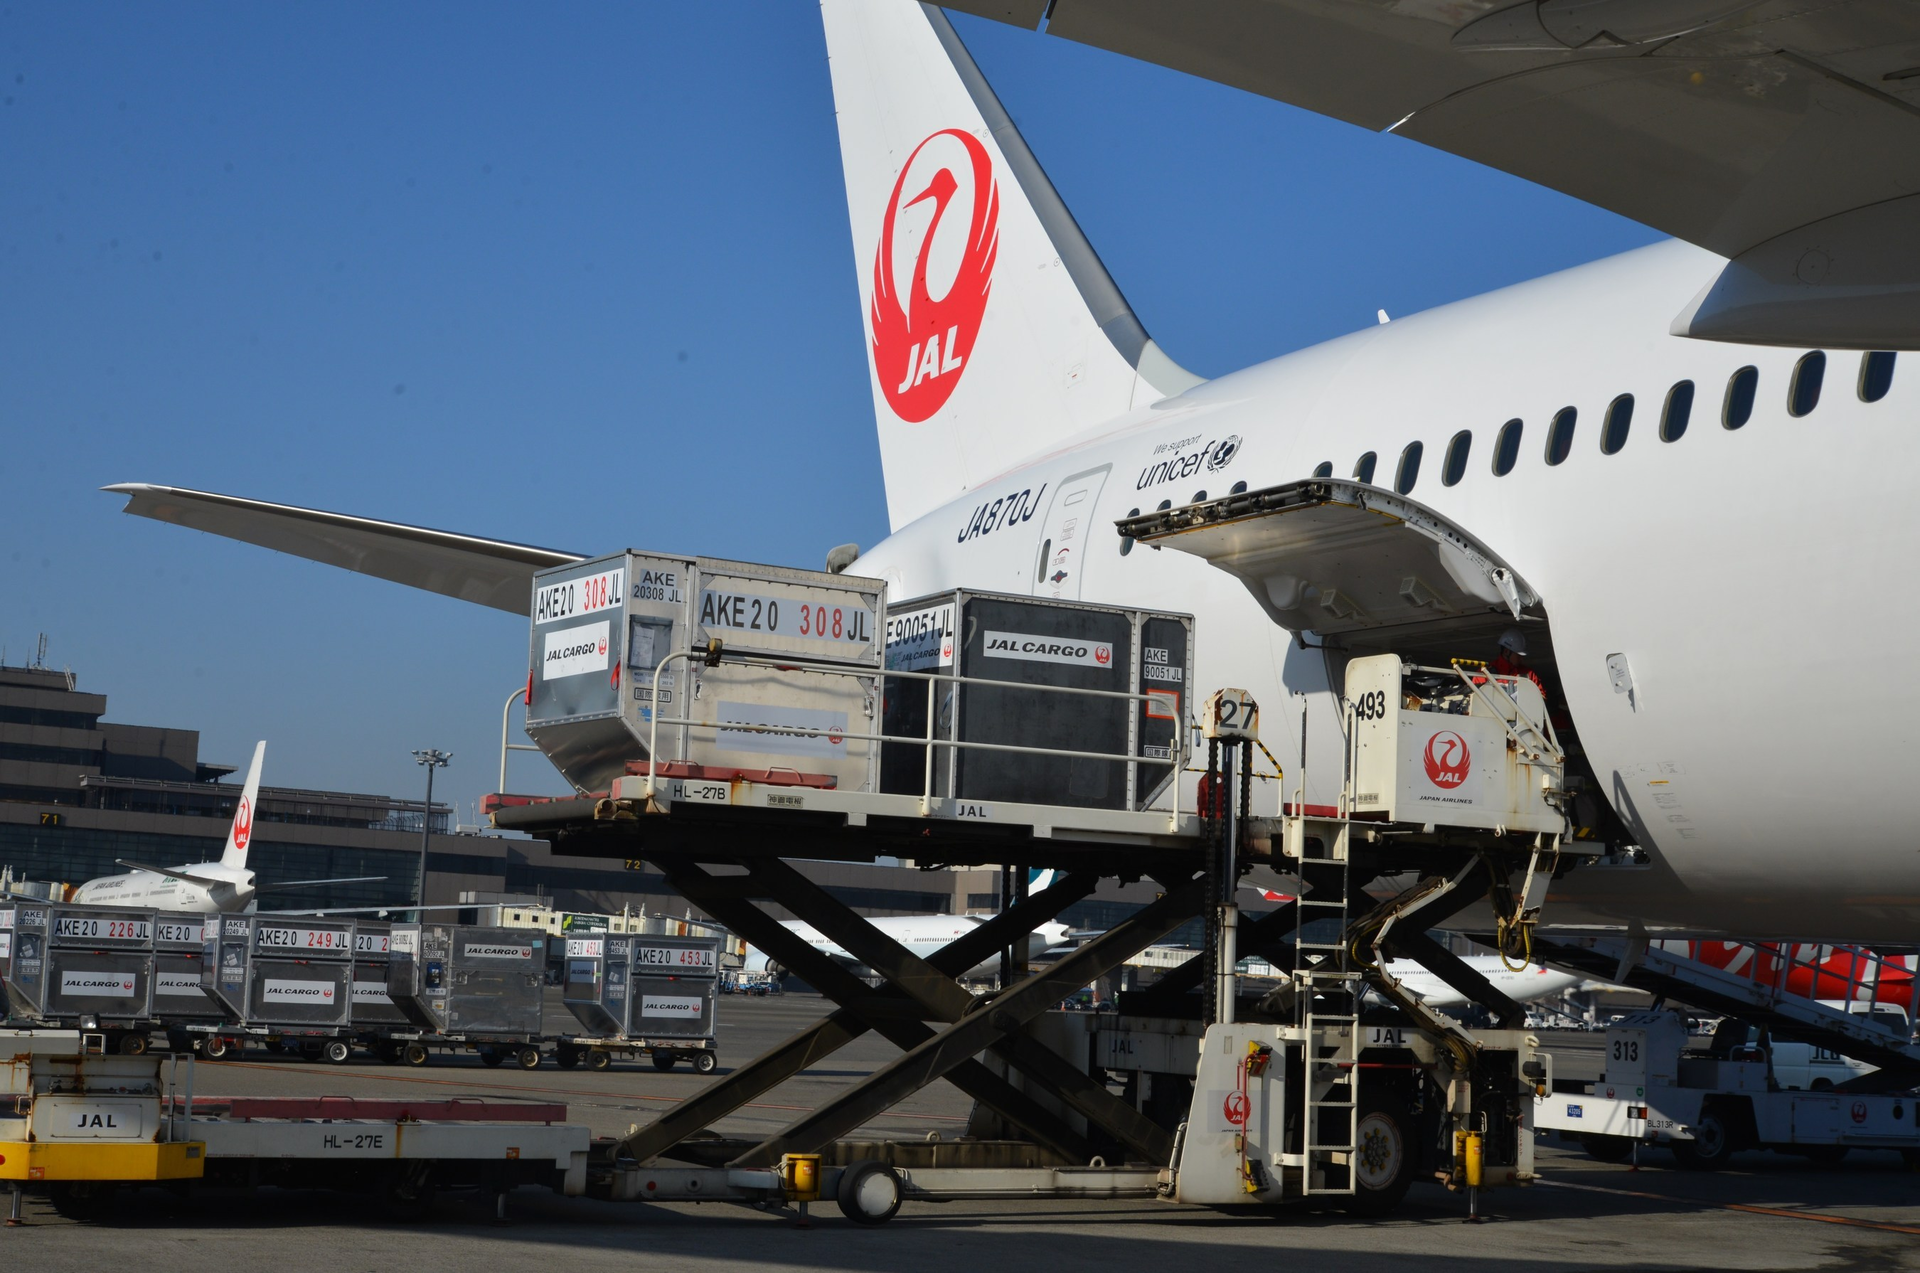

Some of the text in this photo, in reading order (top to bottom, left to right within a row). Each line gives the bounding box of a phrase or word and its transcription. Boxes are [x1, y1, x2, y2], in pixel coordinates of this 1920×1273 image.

[897, 324, 963, 395] JAL
[1153, 433, 1202, 456] We support
[1136, 439, 1216, 491] unicef
[957, 482, 1048, 544] JA870J
[642, 570, 675, 587] AKE
[633, 584, 682, 603] 20308 JL
[537, 584, 574, 621] AKE20
[700, 593, 778, 632] AKE20
[1145, 649, 1167, 663] AKE
[636, 689, 669, 701] 国際用
[1356, 690, 1386, 721] 493
[1219, 699, 1257, 730] 27
[1435, 771, 1462, 783] JAL
[673, 784, 726, 800] HL-27B
[1419, 795, 1473, 805] JAPAN AIRLINES
[957, 804, 987, 818] JAL
[41, 813, 58, 825] 71
[236, 833, 247, 844] JAL
[625, 859, 641, 870] 72
[1156, 892, 1164, 900] 7
[18, 917, 36, 925] 20226
[37, 918, 45, 926] JL
[54, 919, 98, 936] AKE20
[222, 927, 239, 935] 20249
[257, 928, 297, 946] AKE20
[355, 936, 372, 950] 20
[635, 949, 671, 964] AKE20
[1372, 1028, 1406, 1043] JAL
[1112, 1039, 1133, 1054] JAL
[1613, 1040, 1638, 1062] 313
[77, 1114, 117, 1128] JAL
[1647, 1119, 1674, 1129] BL313R
[324, 1134, 383, 1149] HL-27E
